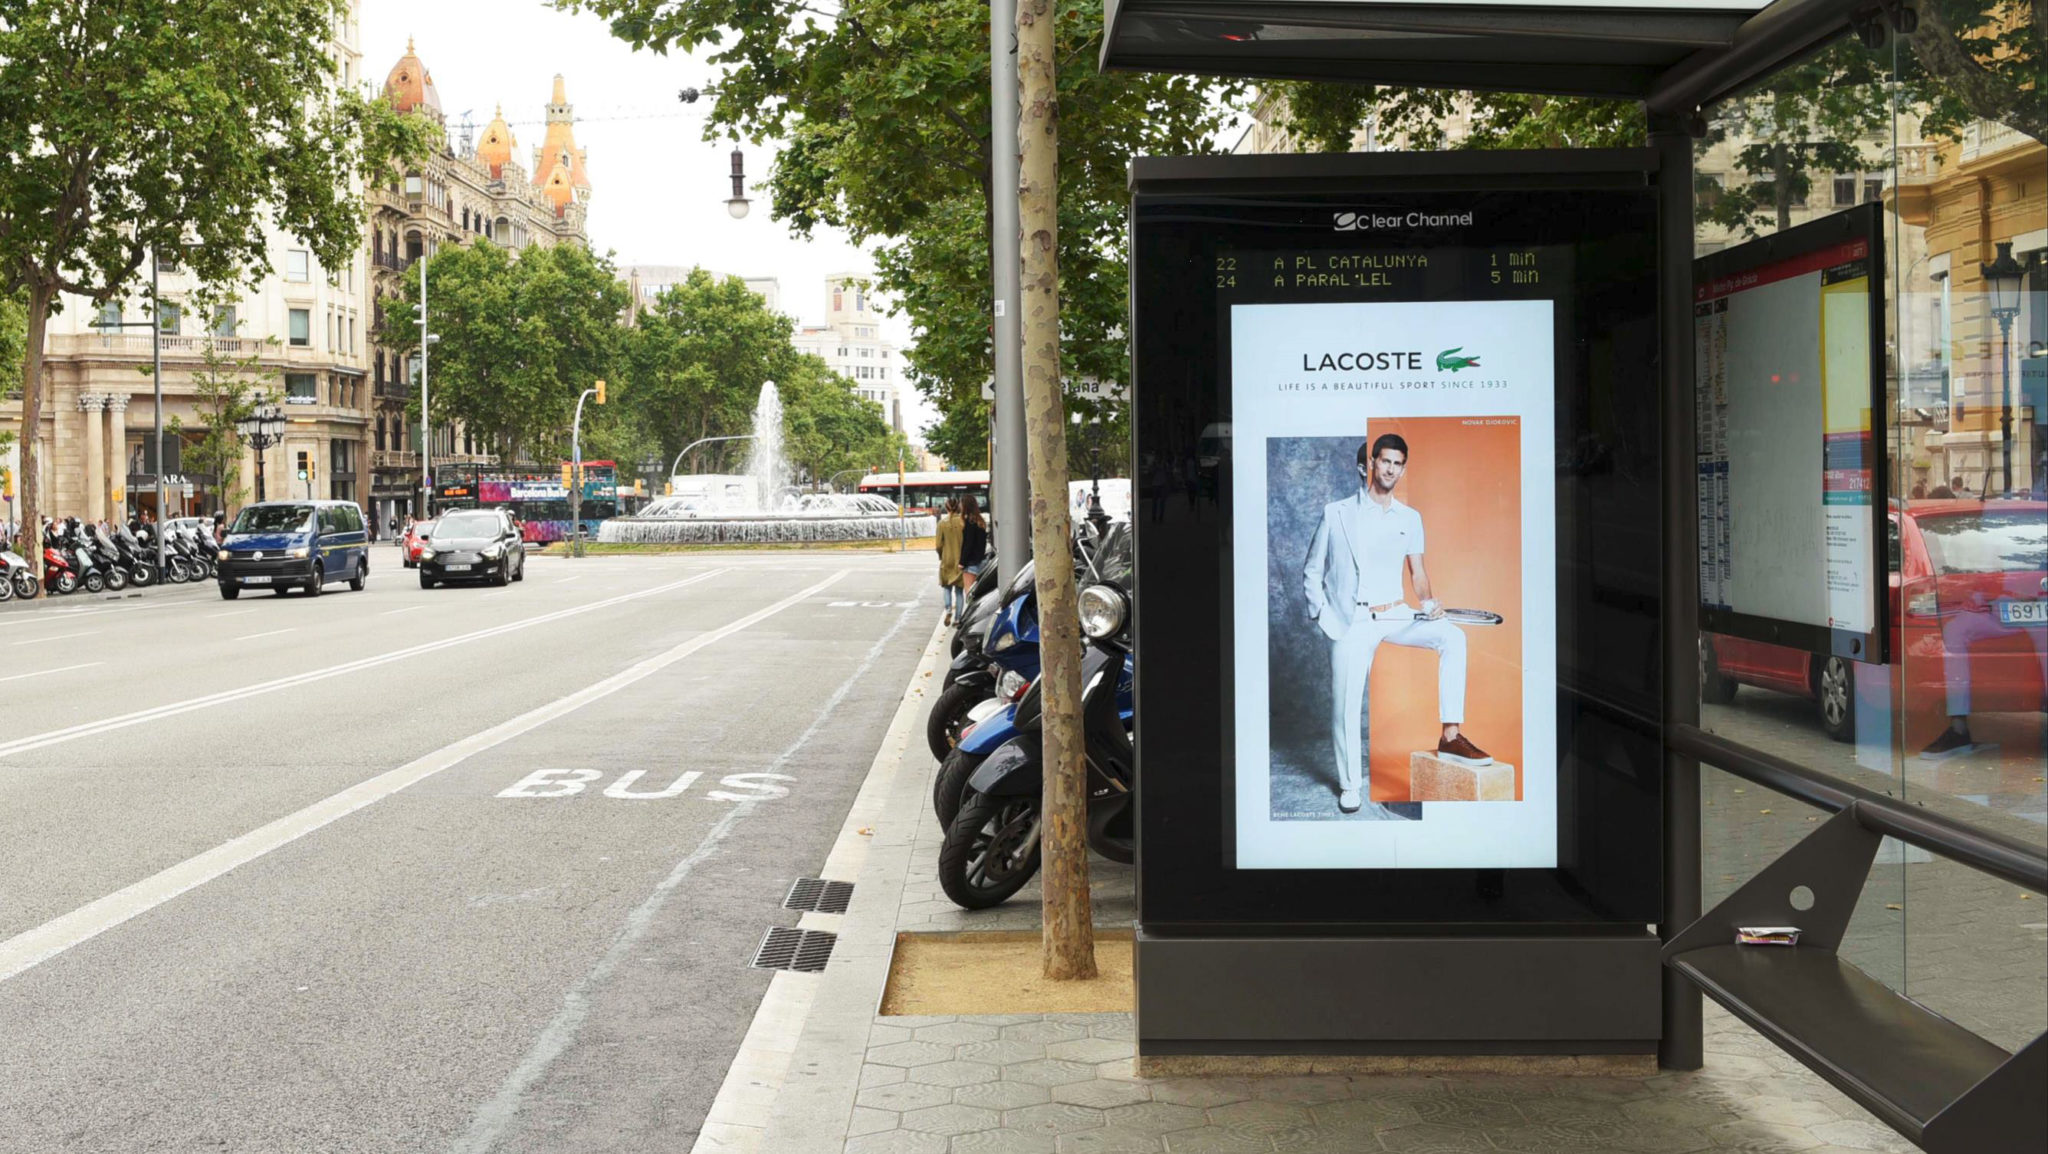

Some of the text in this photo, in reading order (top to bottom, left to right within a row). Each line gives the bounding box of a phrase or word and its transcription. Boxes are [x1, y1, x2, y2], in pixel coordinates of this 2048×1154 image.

[1357, 211, 1473, 229] Clear Channel
[1216, 252, 1536, 271] 22 A PL CATALUNYA 1 min
[1216, 274, 1237, 288] 24
[1274, 274, 1285, 287] A
[1491, 271, 1501, 284] 5
[1513, 270, 1539, 284] min
[1303, 352, 1422, 371] LACOSTE
[1278, 380, 1508, 391] LIFE IS A BEAUTIFUL SPORT SINCE 1933
[154, 474, 187, 484] ARA
[2012, 604, 2048, 620] 691
[493, 768, 798, 801] BUS
